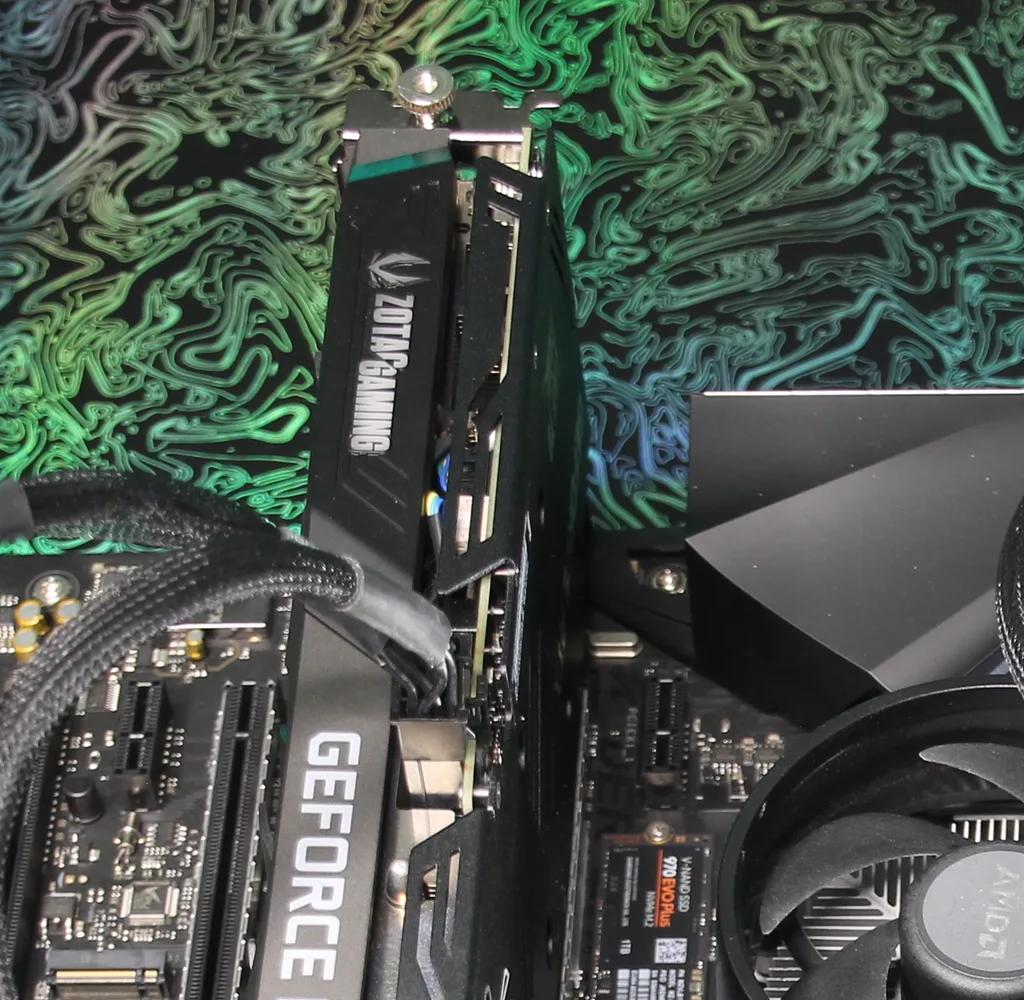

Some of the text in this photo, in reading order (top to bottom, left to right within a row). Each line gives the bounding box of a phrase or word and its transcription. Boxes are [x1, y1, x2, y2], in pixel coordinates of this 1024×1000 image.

[350, 293, 415, 451] ZOTAC GAMING
[280, 731, 362, 981] GEFORCE
[660, 856, 678, 928] 970 EVO Plus
[678, 857, 693, 912] V-NAND SSD
[620, 939, 632, 955] 1TB
